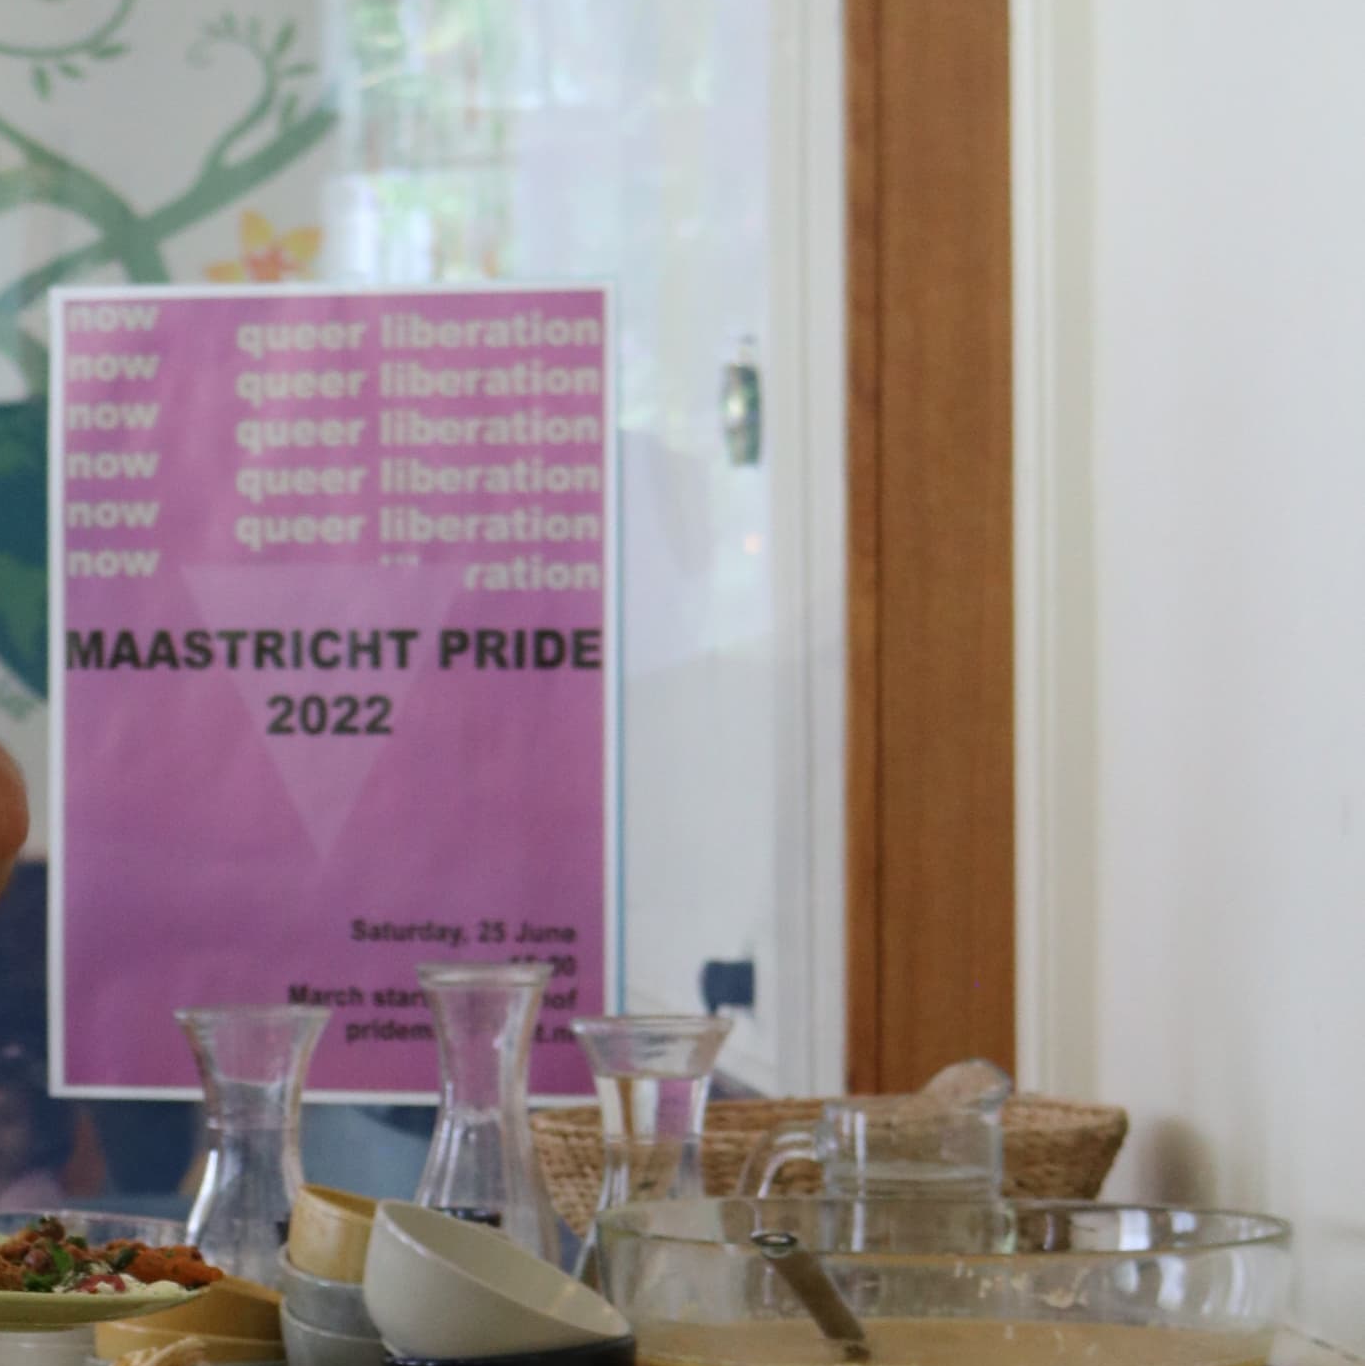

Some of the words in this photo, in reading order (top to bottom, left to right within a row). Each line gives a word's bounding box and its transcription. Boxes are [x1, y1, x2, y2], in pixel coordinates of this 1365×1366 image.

[66, 304, 160, 331] now
[236, 319, 366, 356] queer
[380, 310, 601, 350] liberation
[66, 354, 160, 381] now
[236, 368, 366, 405] queer
[380, 359, 601, 399] liberation
[66, 403, 160, 430] now
[236, 417, 366, 454] queer
[380, 408, 601, 448] liberation
[66, 452, 160, 479] now
[236, 466, 366, 503] queer
[380, 457, 601, 497] liberation
[66, 500, 160, 527] now
[236, 513, 366, 550] queer
[380, 504, 601, 544] liberation
[66, 549, 160, 576] now
[66, 629, 419, 670] MAASTRICHT
[439, 629, 602, 670] PRIDE
[267, 695, 393, 735] 2022
[478, 921, 506, 943] 25
[515, 921, 577, 943] June
[288, 986, 364, 1007] March
